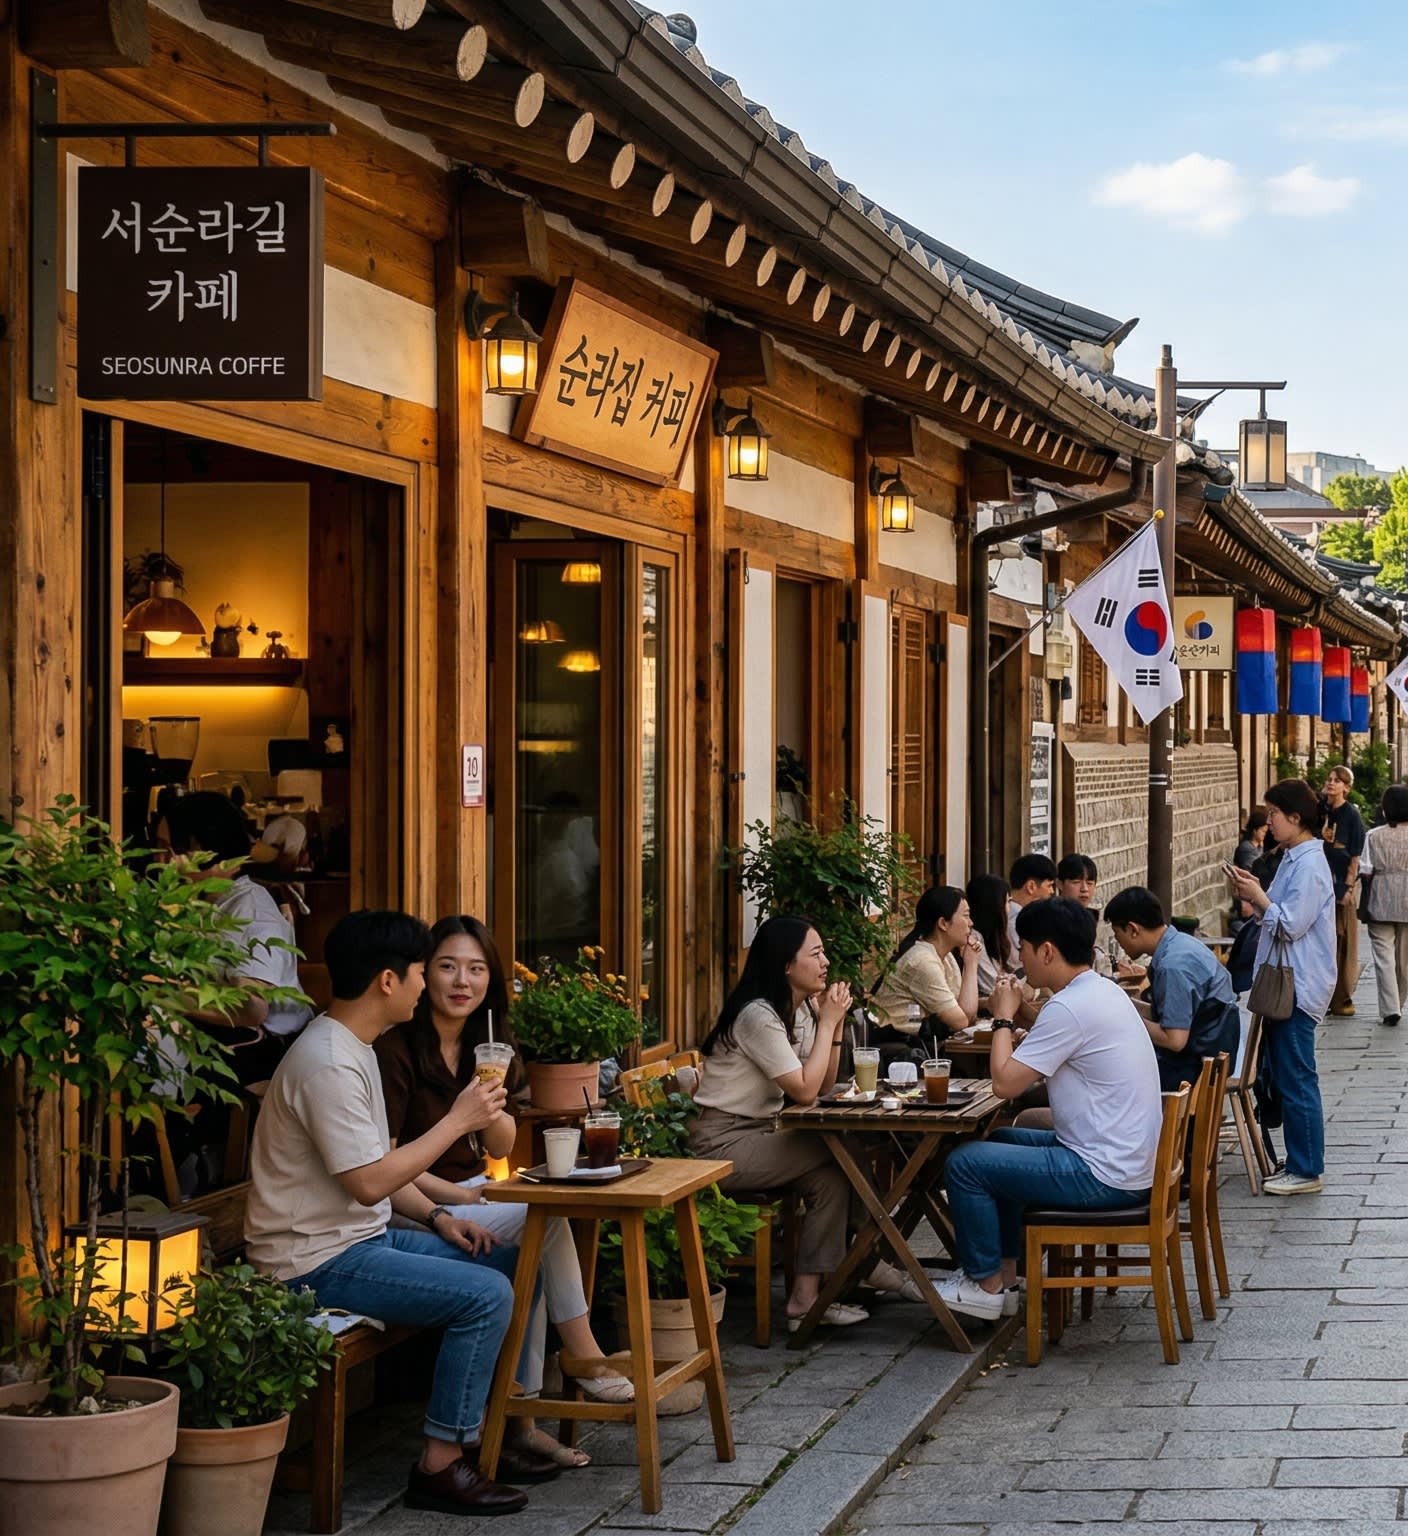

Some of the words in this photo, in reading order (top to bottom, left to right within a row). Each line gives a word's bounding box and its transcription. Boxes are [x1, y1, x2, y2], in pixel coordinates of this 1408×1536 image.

[101, 201, 286, 255] 서순라길
[147, 269, 239, 323] 카페
[101, 356, 213, 375] SEOSUNRA
[218, 356, 286, 375] COFFE
[557, 335, 645, 427] 순라집
[640, 371, 694, 448] 커피
[467, 757, 478, 778] 10
